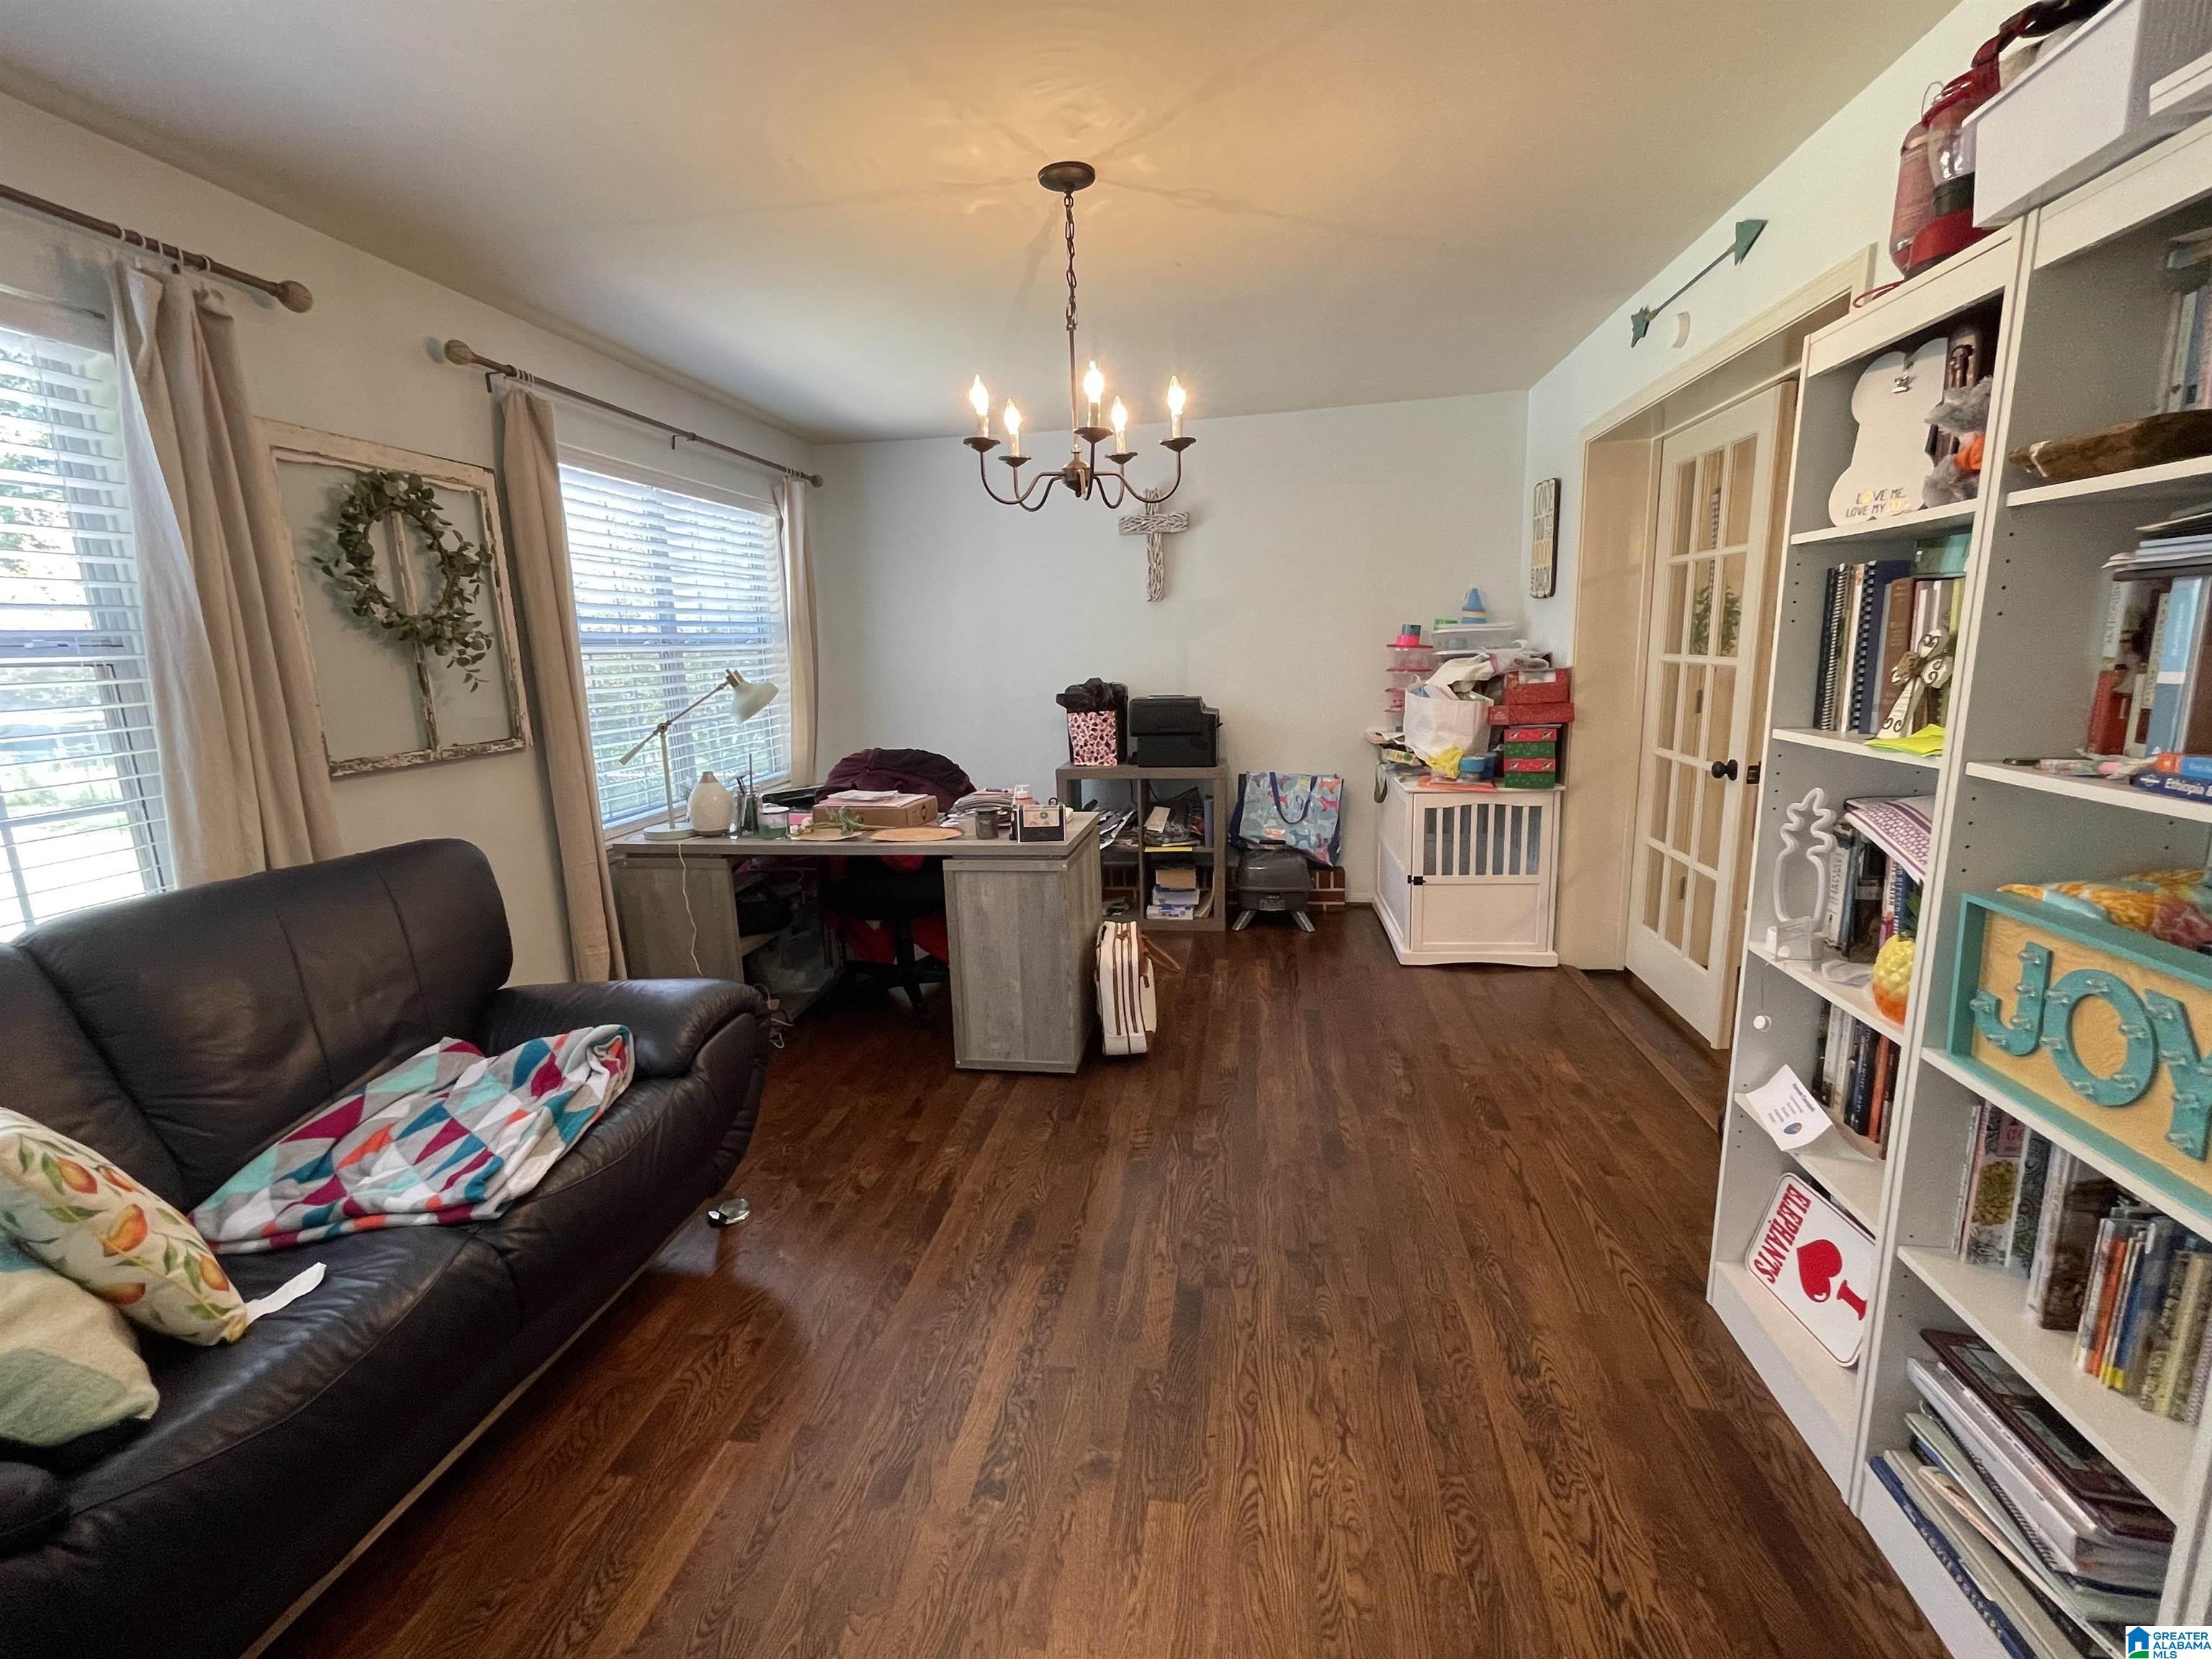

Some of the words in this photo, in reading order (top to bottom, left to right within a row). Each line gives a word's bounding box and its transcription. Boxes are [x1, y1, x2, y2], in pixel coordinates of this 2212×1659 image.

[1890, 487, 1907, 500] ME
[1845, 505, 1869, 518] LOVE
[1871, 503, 1887, 514] MY
[2164, 778, 2205, 795] Ethiopia
[1972, 941, 2212, 1164] JOY
[1753, 1183, 1812, 1285] ELEPHANTS
[1837, 1279, 1869, 1321] I
